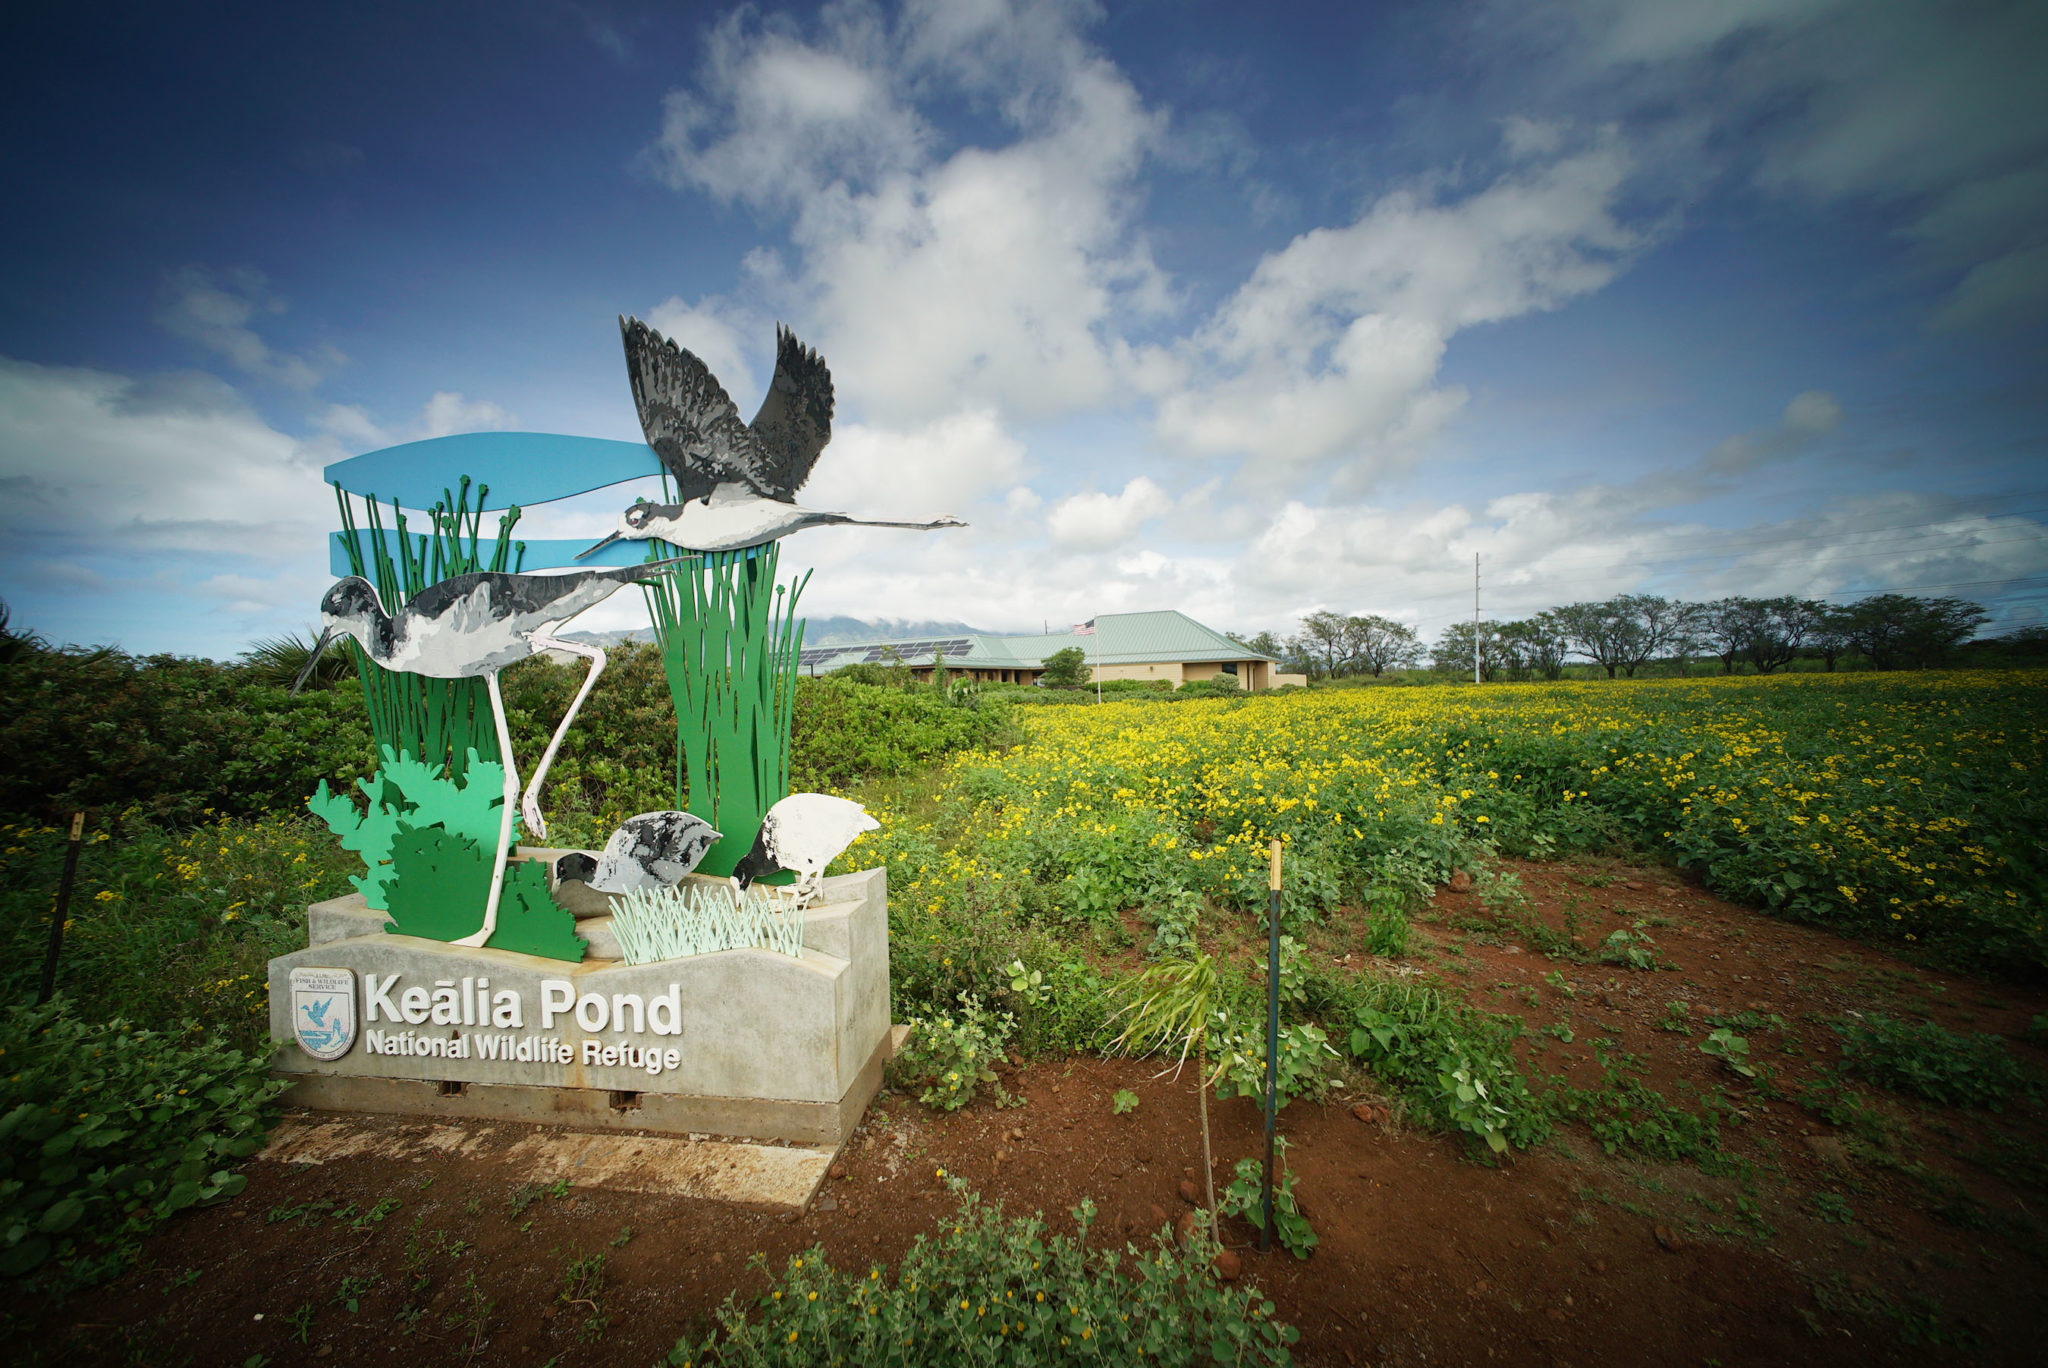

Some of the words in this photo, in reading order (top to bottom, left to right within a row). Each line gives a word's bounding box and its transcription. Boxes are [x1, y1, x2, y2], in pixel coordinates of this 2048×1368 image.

[365, 974, 524, 1029] Keālia
[541, 979, 682, 1036] Pond
[366, 1029, 471, 1059] National
[475, 1035, 574, 1065] Wildlife
[582, 1039, 681, 1075] Refuge
